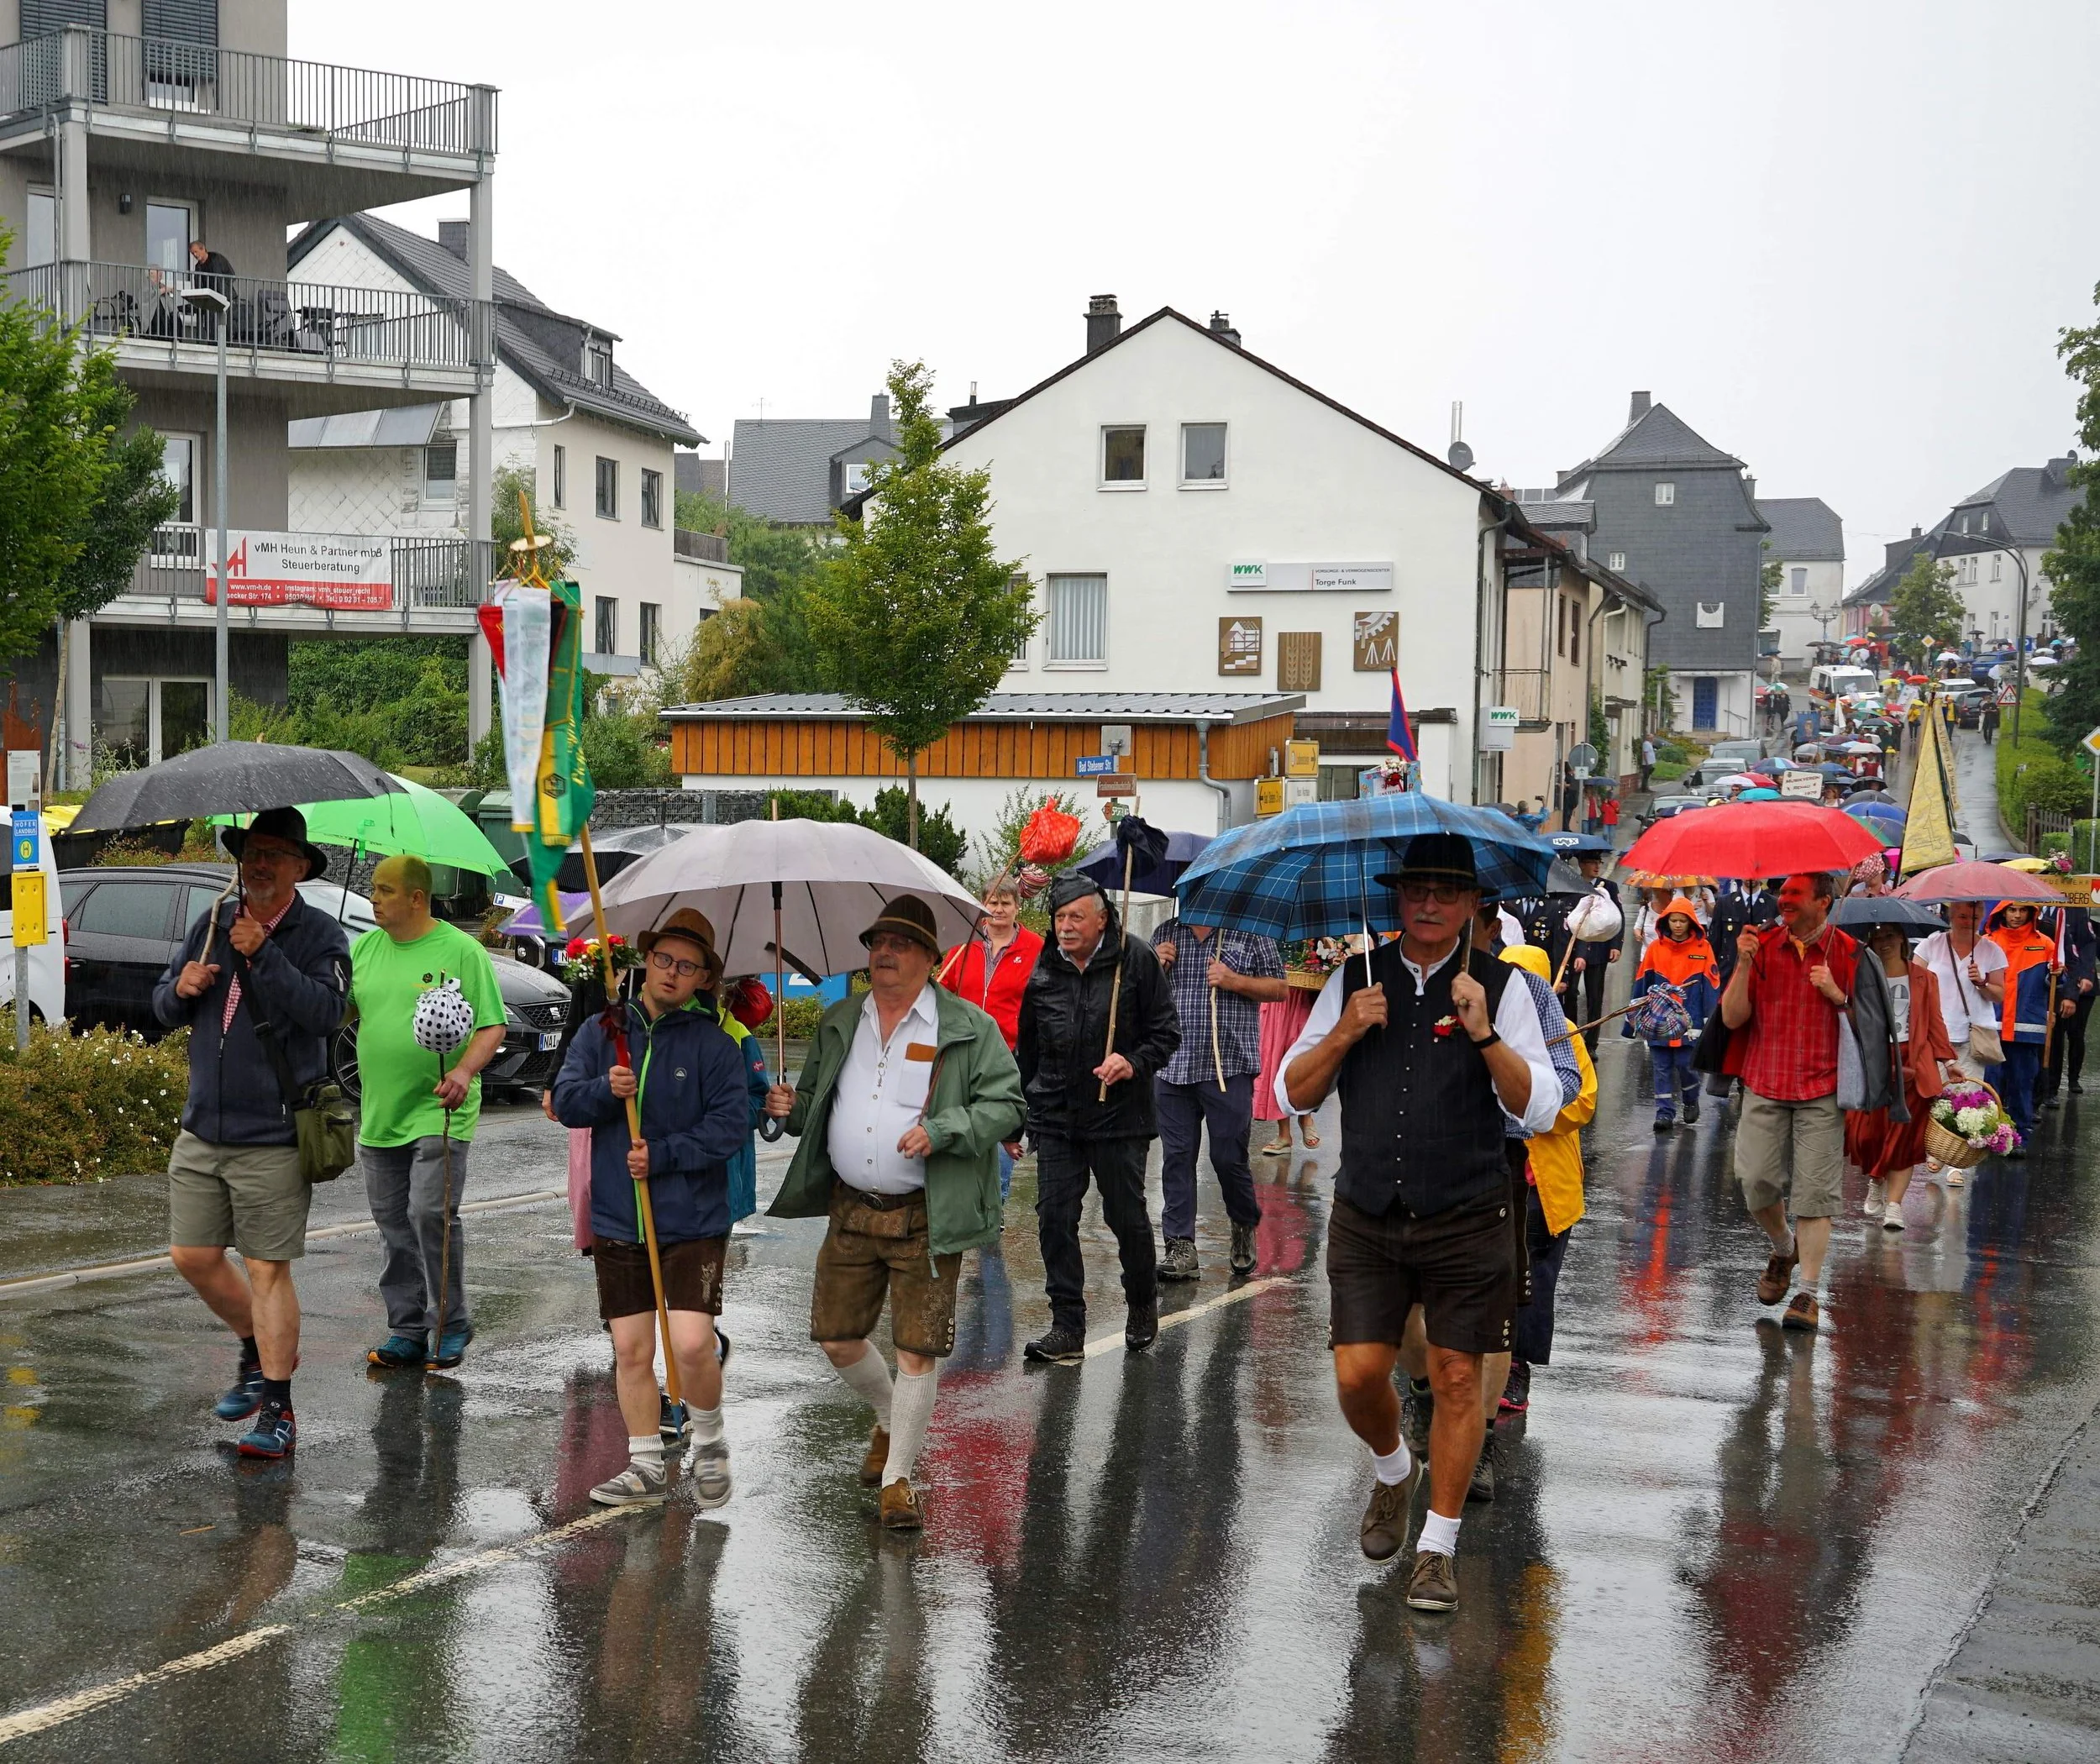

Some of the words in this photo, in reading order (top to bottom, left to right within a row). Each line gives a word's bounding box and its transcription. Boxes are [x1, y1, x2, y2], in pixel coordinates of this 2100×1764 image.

[255, 542, 277, 554] vMH
[281, 543, 307, 554] Heun
[310, 543, 318, 554] &
[321, 545, 358, 558] Partner
[360, 547, 383, 559] mbB
[281, 559, 360, 575] Steuerberatung
[1233, 564, 1263, 575] WWK
[285, 584, 317, 592] Instagram:
[1315, 579, 1336, 587] Torge
[1491, 711, 1517, 720] WWK
[1079, 760, 1087, 772] Bad
